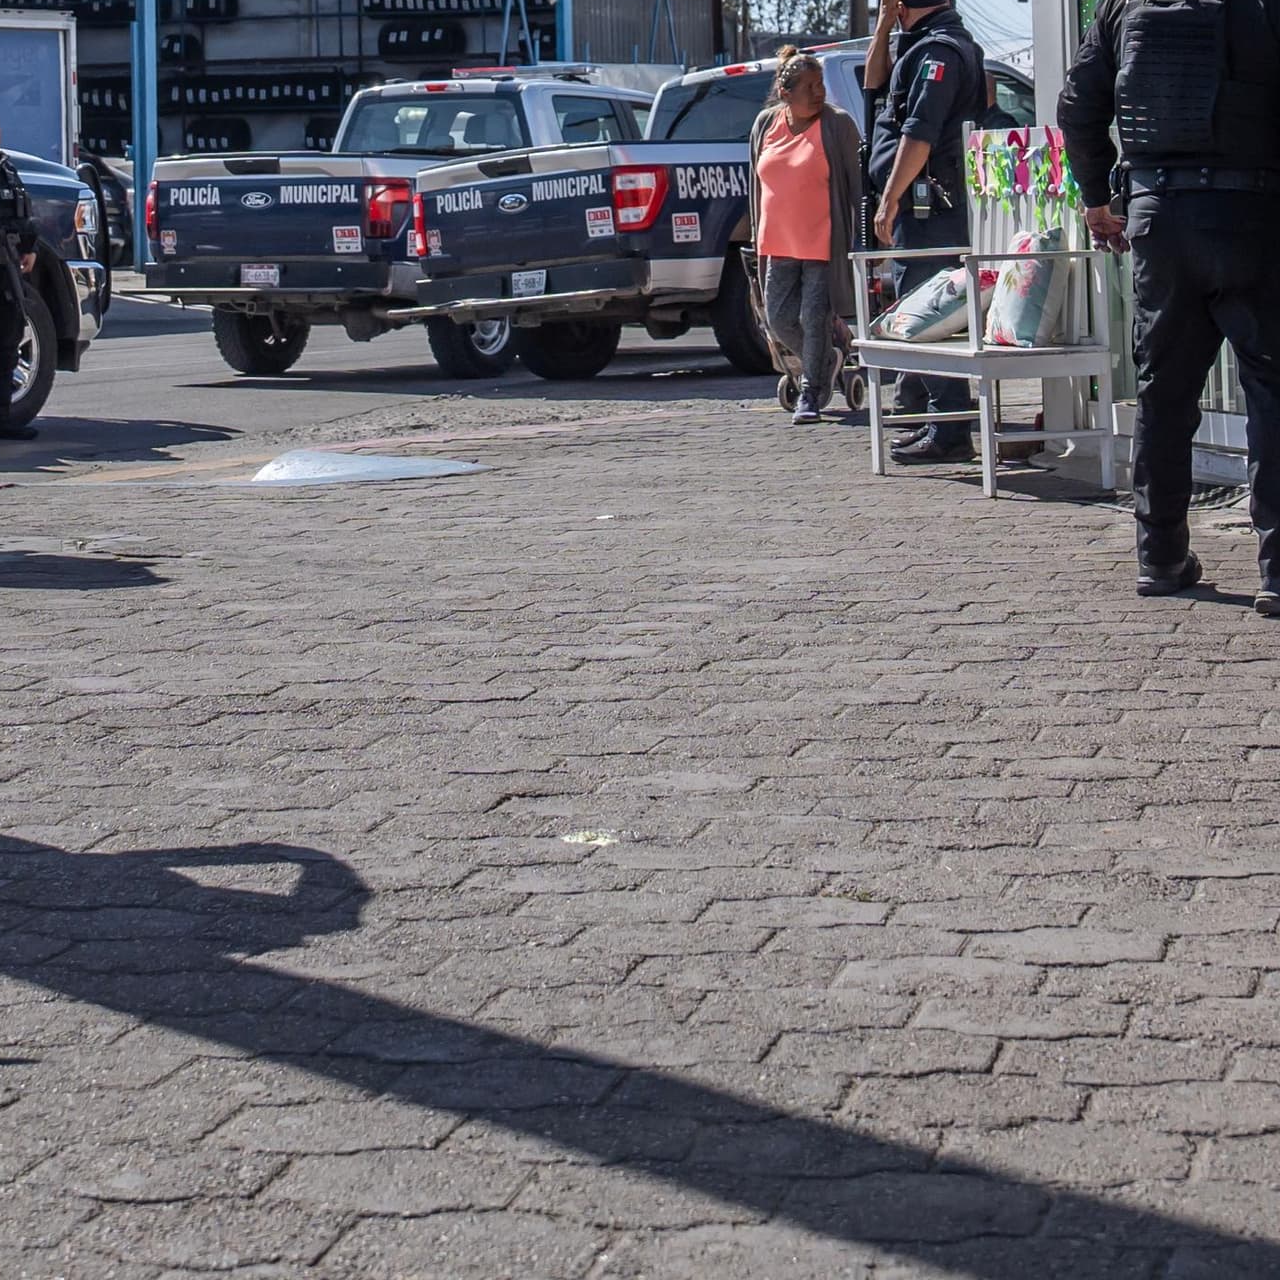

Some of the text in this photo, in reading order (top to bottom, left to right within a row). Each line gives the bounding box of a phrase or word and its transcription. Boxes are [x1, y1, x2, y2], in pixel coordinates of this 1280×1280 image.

[170, 183, 220, 206] POLICÍA
[279, 184, 358, 204] MUNICIPAL
[436, 188, 483, 214] POLICÍA
[531, 174, 606, 201] MUNICIPAL
[676, 165, 748, 200] BC-968-A1
